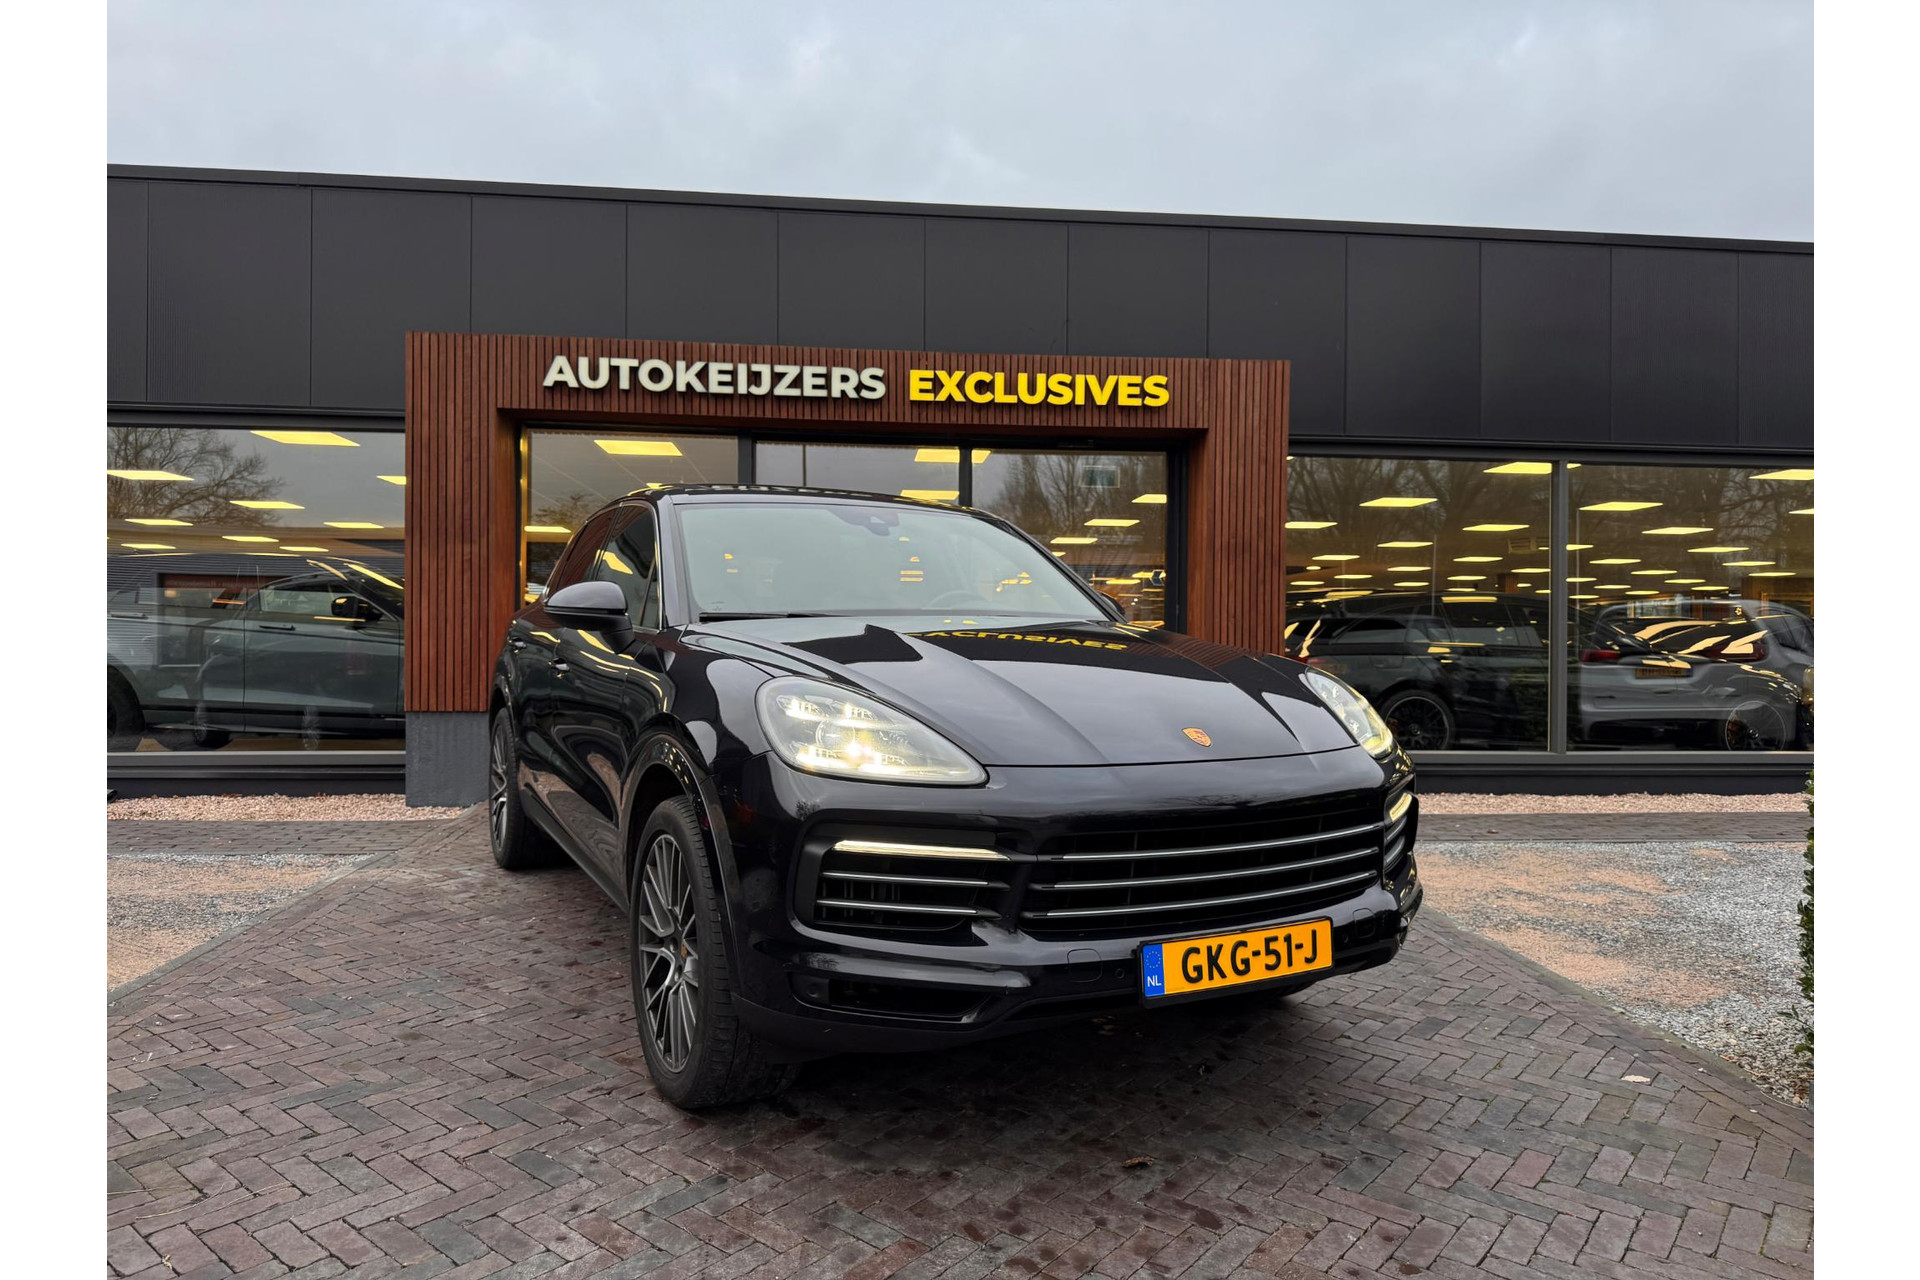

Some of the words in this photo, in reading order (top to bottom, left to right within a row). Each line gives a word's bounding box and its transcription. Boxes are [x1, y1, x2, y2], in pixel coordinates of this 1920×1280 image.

[542, 354, 887, 400] AUTOKEIJZERS
[909, 369, 1170, 407] EXCLUSIVES
[1147, 975, 1162, 988] NL
[1181, 929, 1318, 984] GKG-51-J
